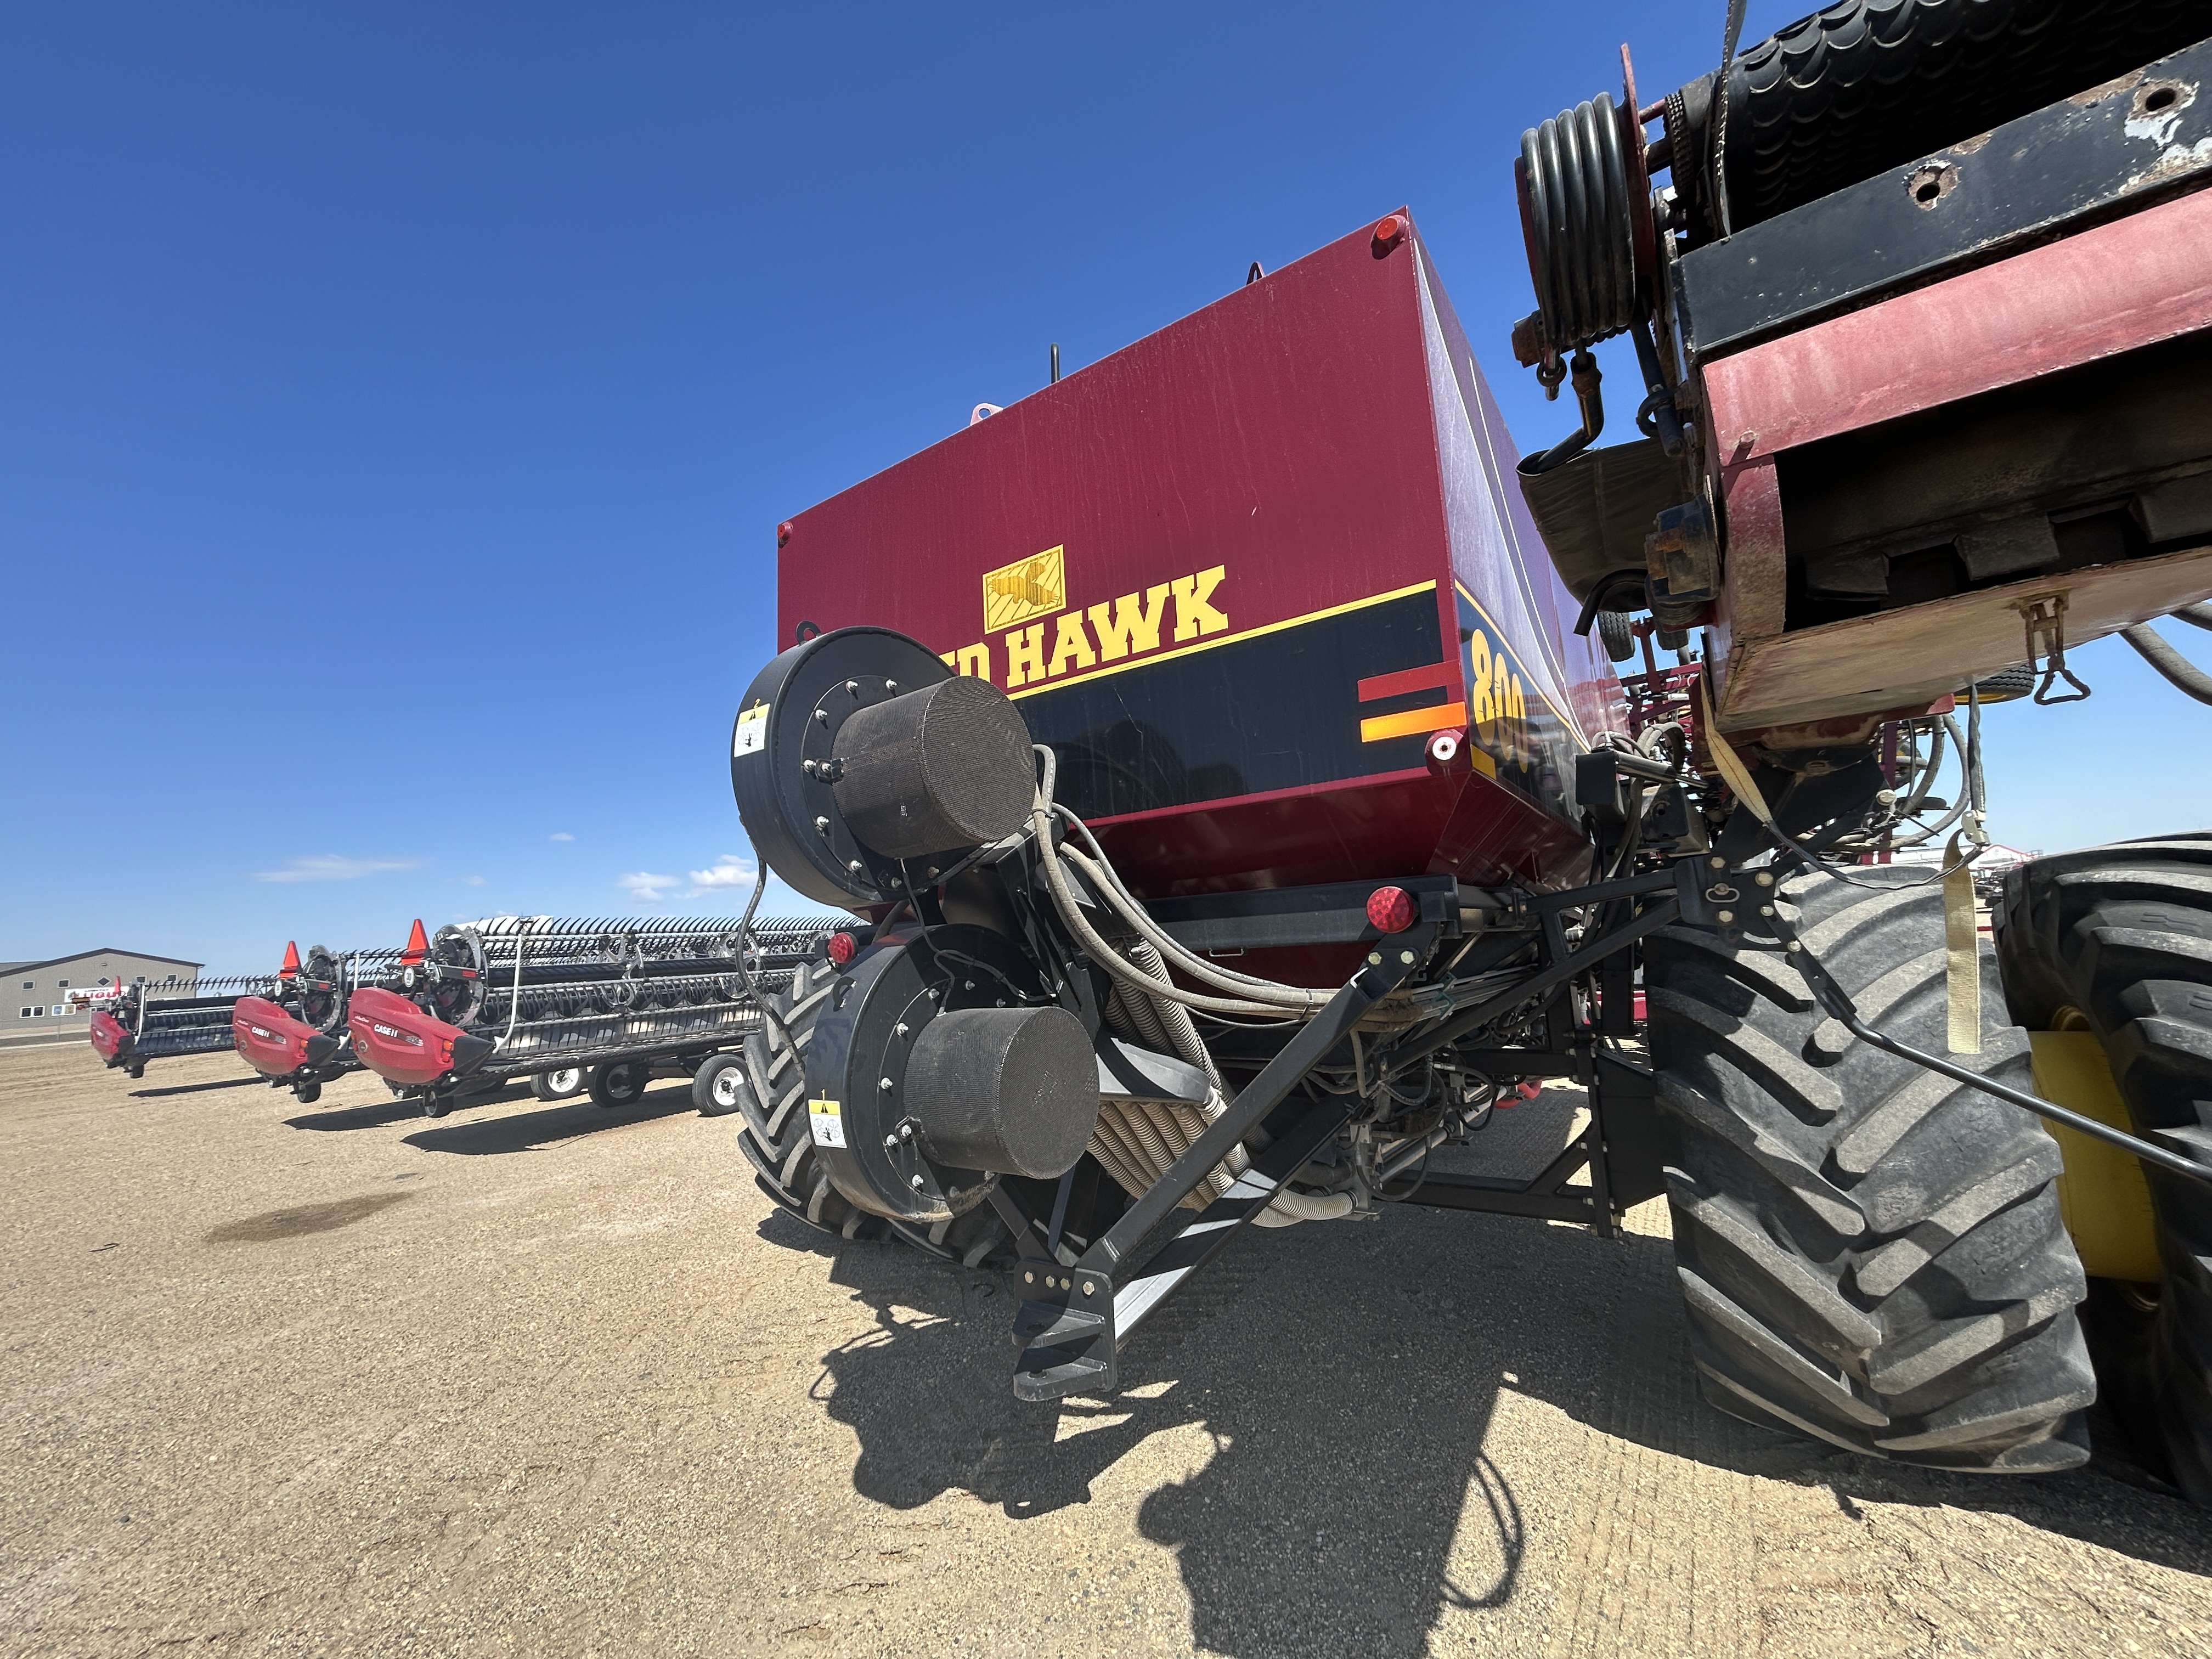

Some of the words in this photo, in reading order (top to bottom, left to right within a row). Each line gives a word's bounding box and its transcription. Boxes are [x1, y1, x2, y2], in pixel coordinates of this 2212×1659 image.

[939, 642, 990, 683] D
[1005, 565, 1228, 689] HAWK
[753, 698, 760, 708] 2
[1471, 629, 1529, 774] 800
[821, 1088, 825, 1101] 1
